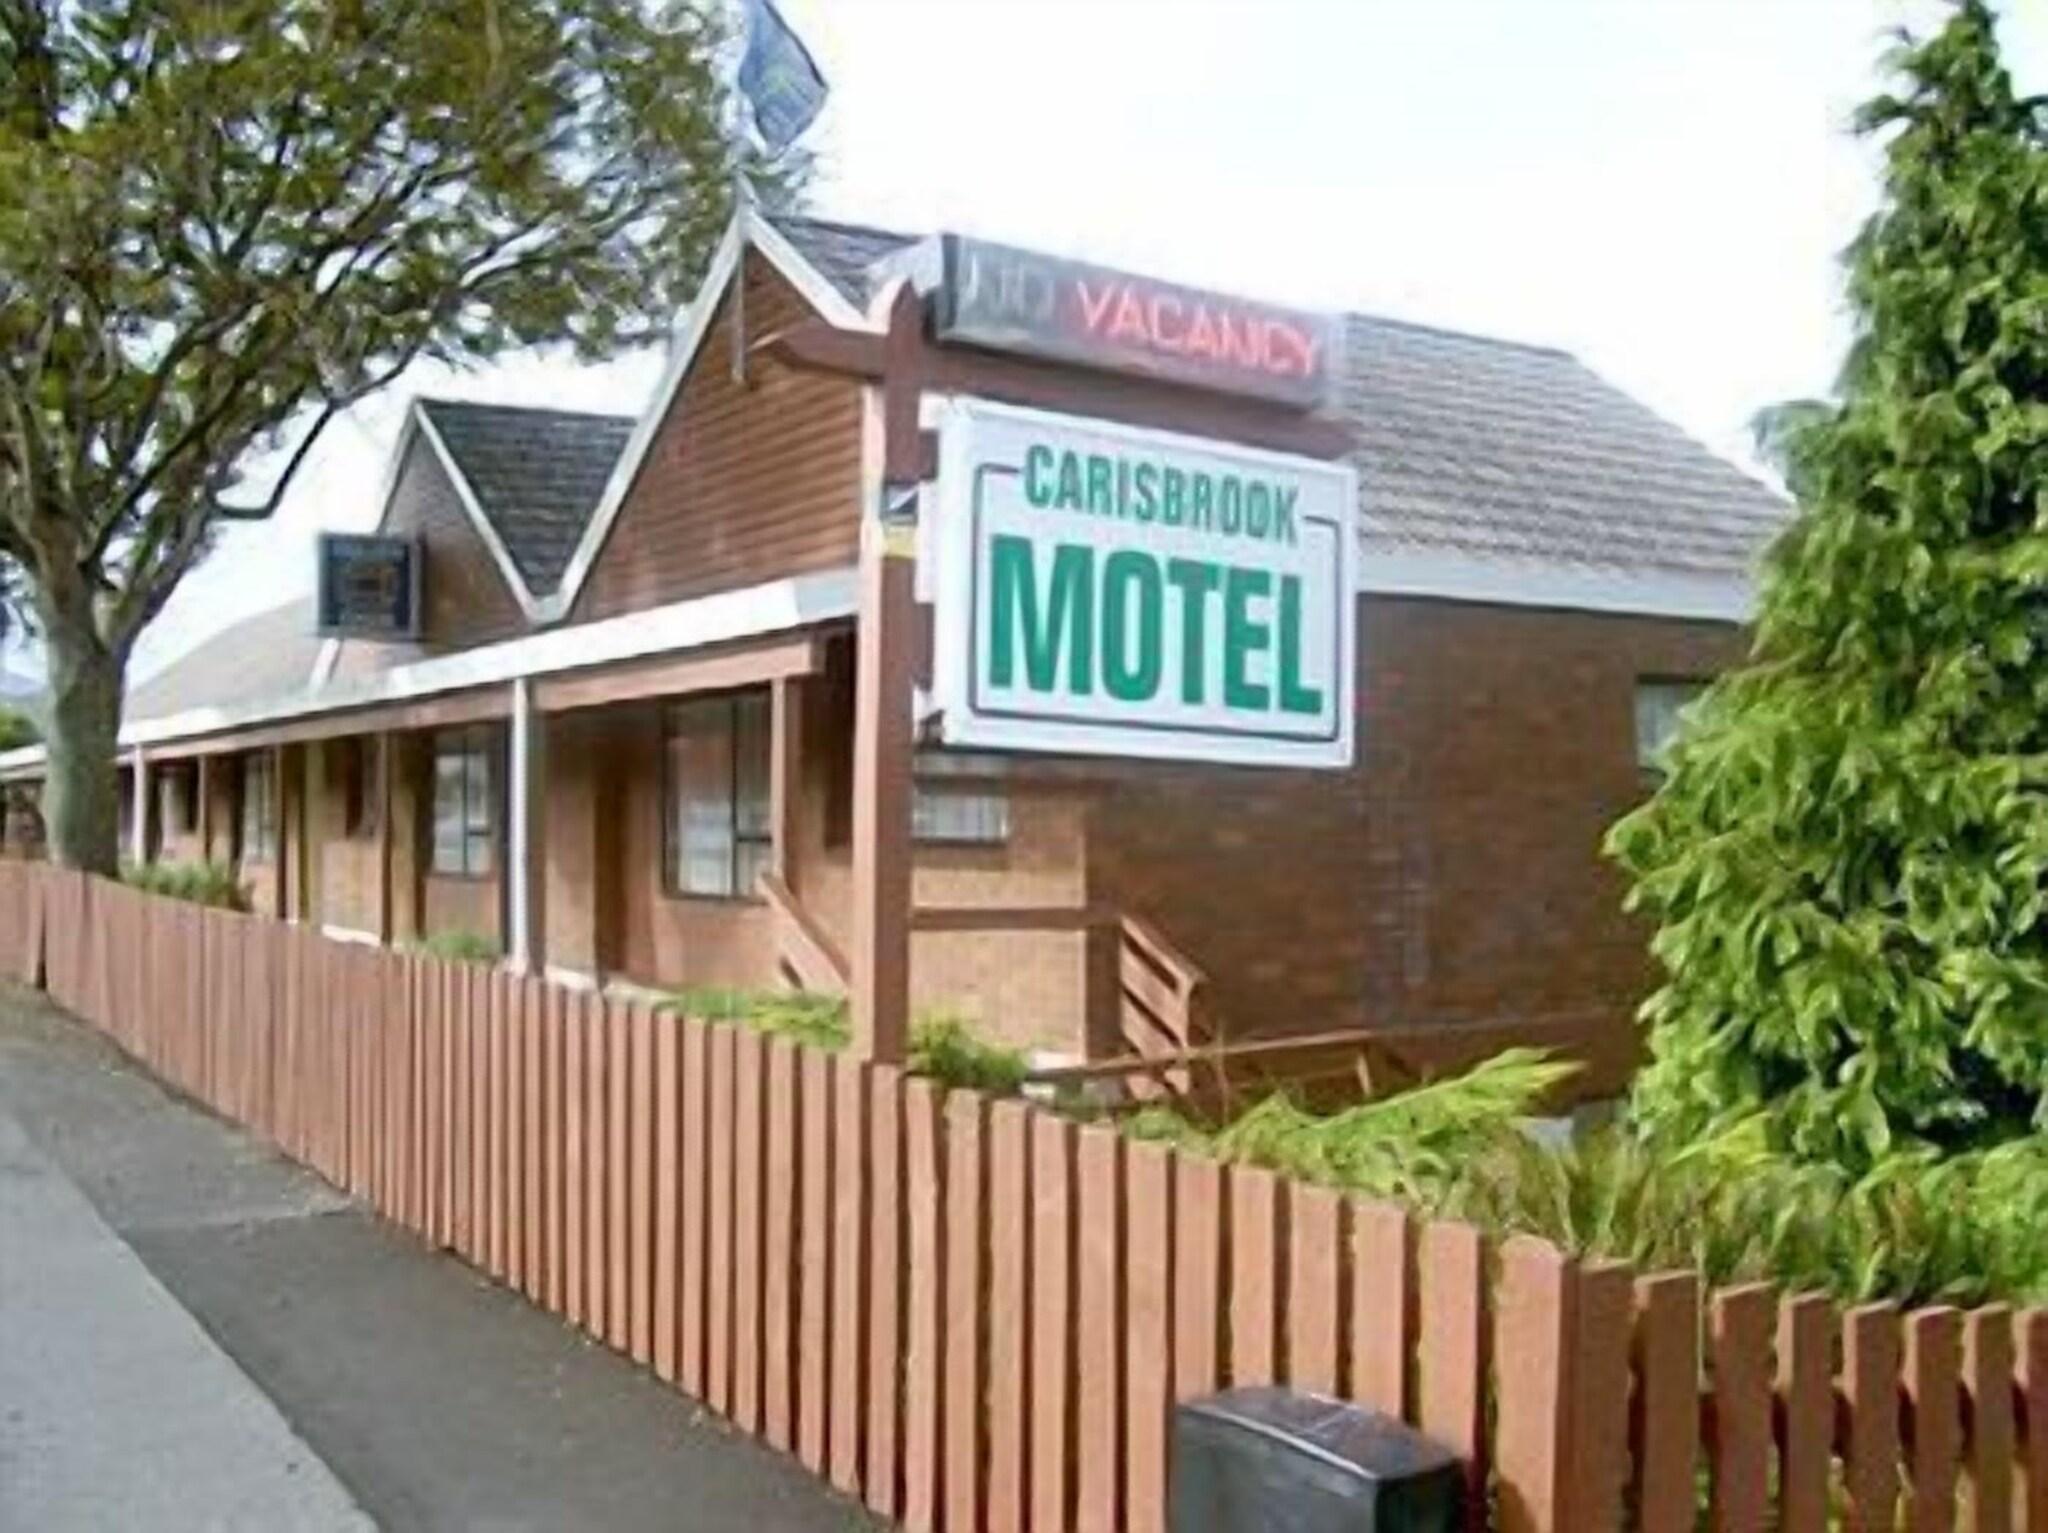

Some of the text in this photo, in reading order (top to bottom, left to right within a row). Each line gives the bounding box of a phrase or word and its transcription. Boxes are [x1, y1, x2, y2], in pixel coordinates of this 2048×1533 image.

[1074, 278, 1320, 376] VACANCY
[1024, 444, 1297, 545] CARISBROOK
[989, 535, 1323, 715] MOTEL
